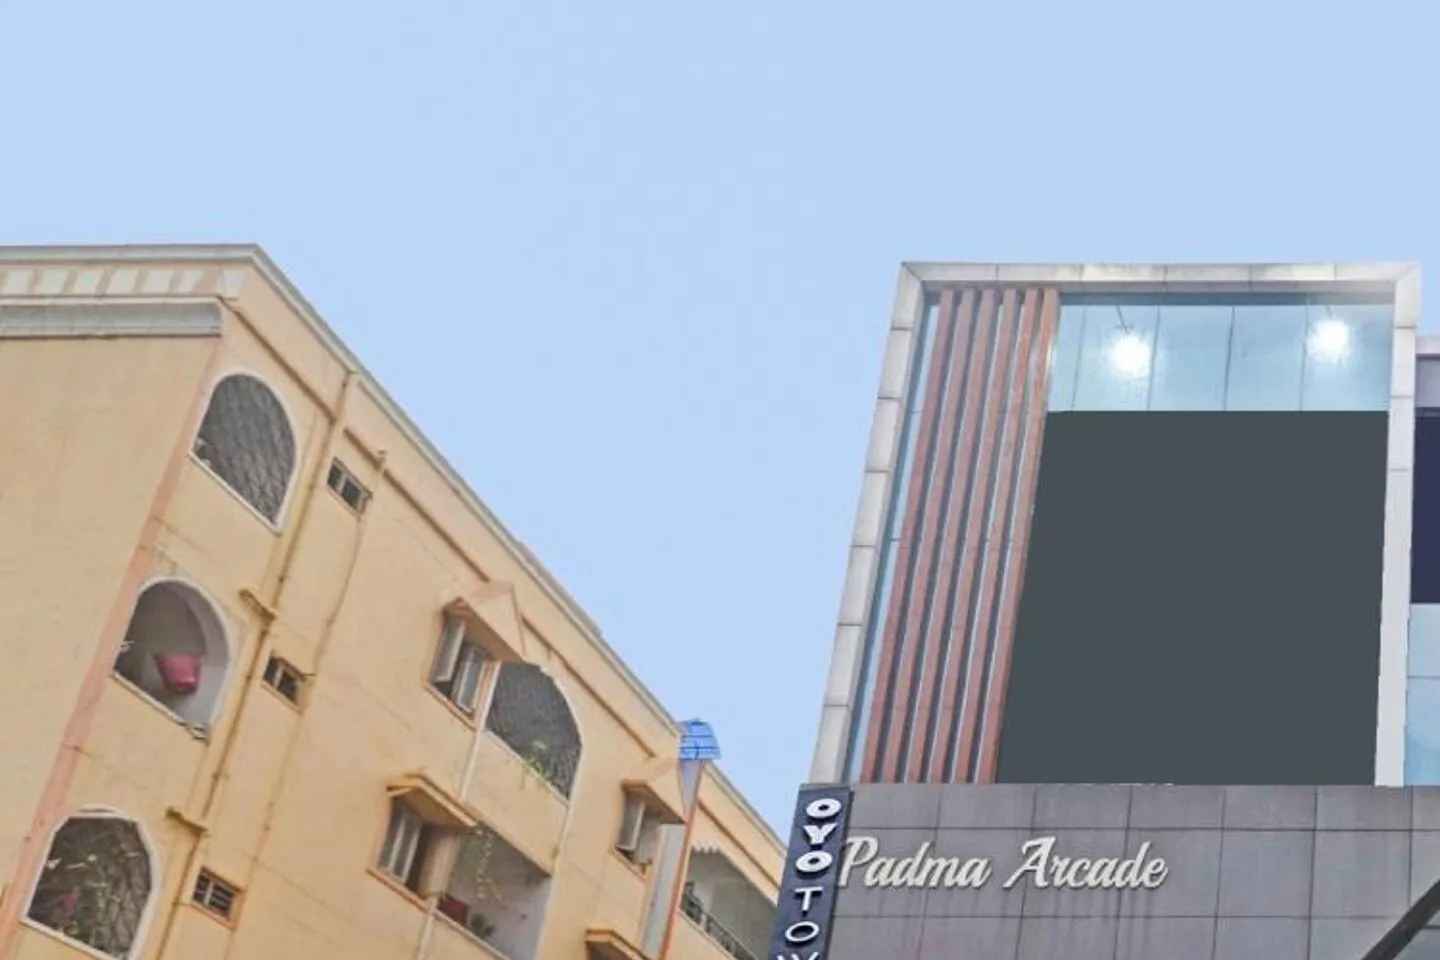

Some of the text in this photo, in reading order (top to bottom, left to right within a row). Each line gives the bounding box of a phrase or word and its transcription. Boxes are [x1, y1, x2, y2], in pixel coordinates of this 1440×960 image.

[796, 797, 842, 873] OYO
[840, 836, 1168, 890] Padma Arcade
